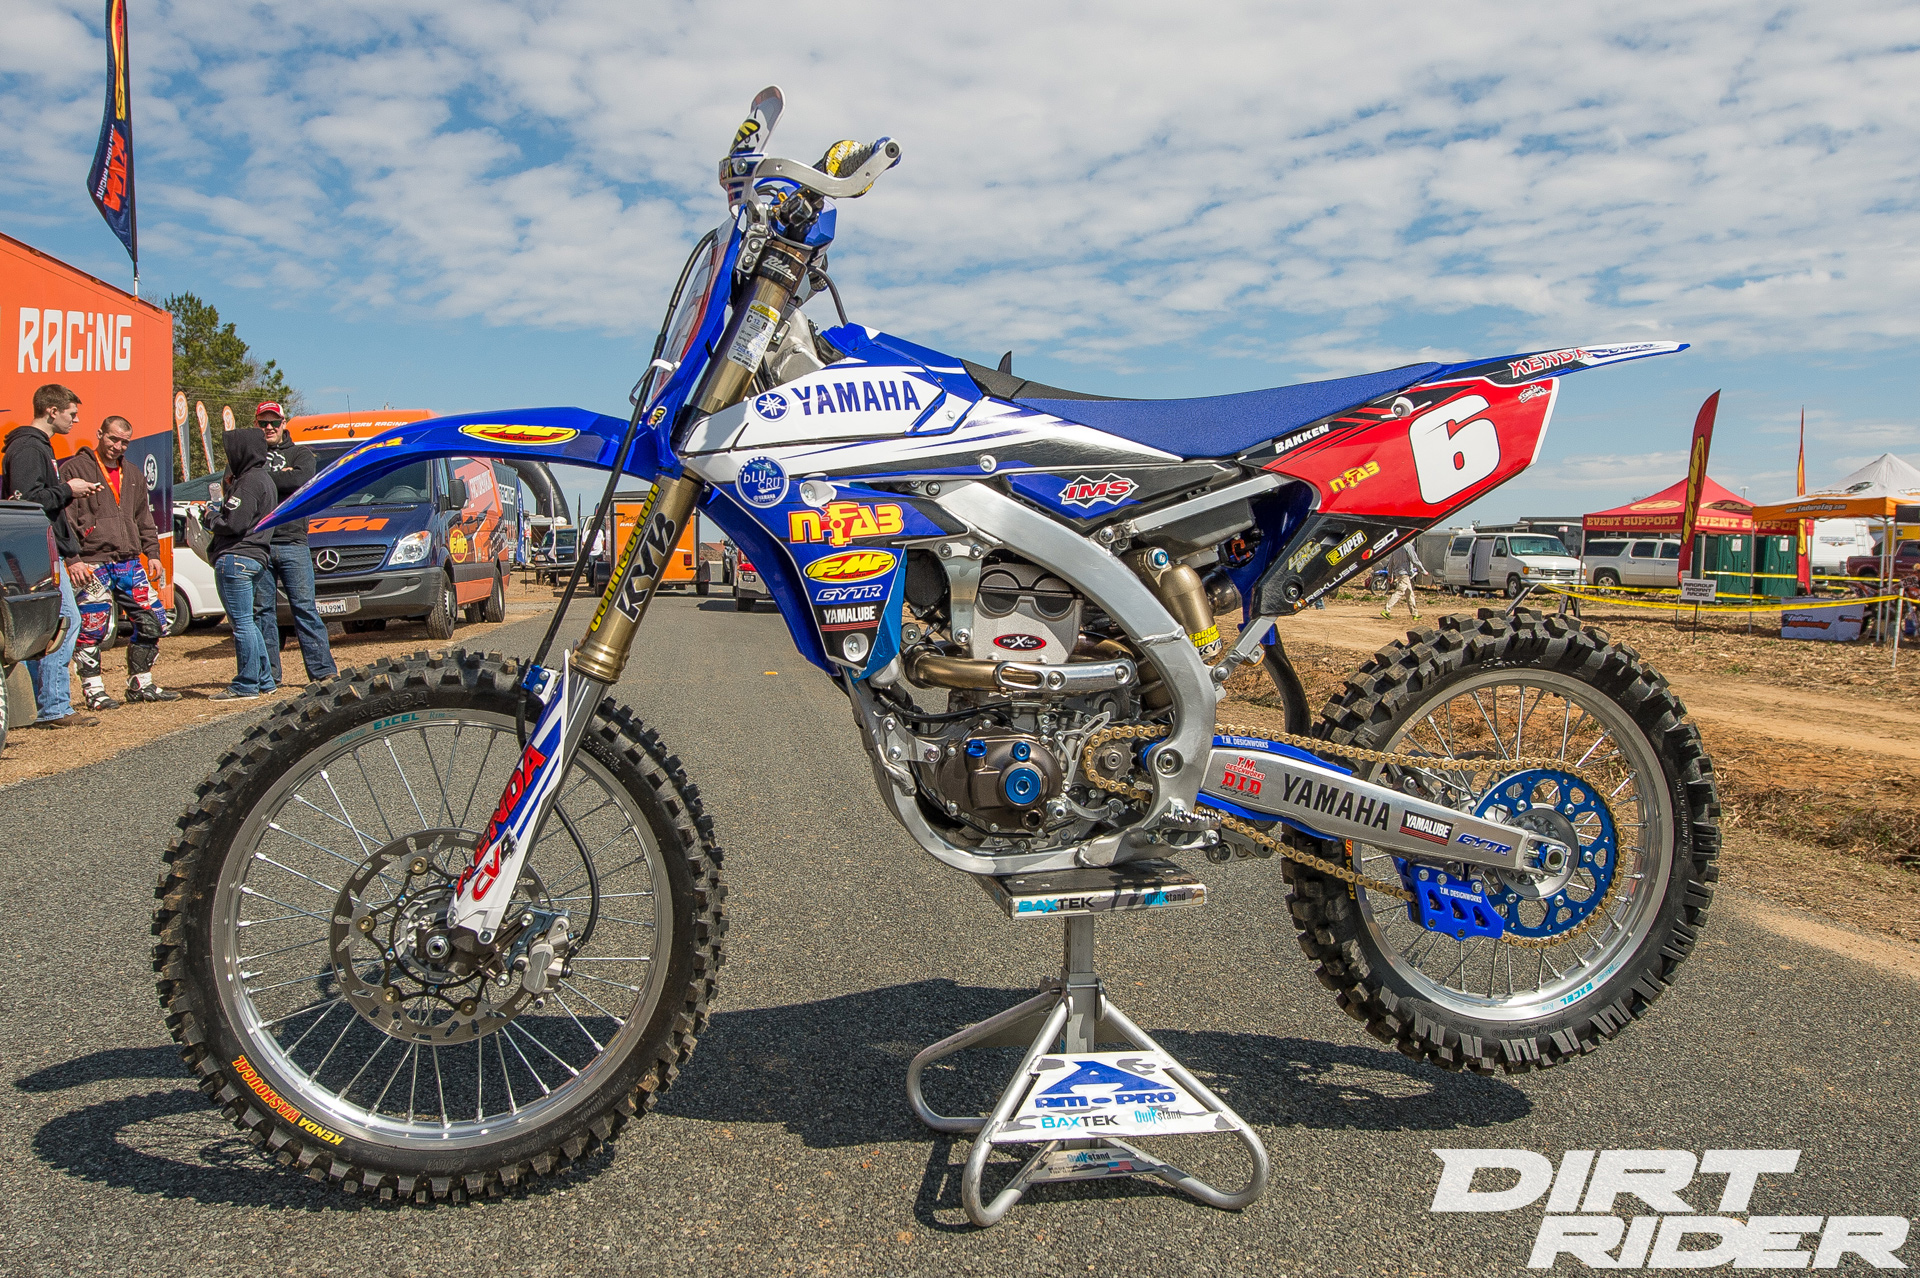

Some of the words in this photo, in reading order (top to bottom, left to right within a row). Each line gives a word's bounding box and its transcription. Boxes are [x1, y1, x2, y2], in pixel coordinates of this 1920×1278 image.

[1508, 348, 1592, 378] KENDA
[792, 381, 921, 415] YAMAHA
[462, 415, 577, 437] FMF
[1275, 424, 1329, 453] BAKKEN
[1409, 394, 1500, 504] 6
[758, 476, 780, 490] CRU
[1067, 481, 1132, 499] IMS
[1587, 517, 1620, 526] EVENT
[1623, 516, 1678, 526] SUPPORT
[1337, 531, 1365, 558] TAPER
[615, 512, 676, 622] KYB
[806, 554, 894, 578] FMF
[816, 585, 883, 601] GYTR
[1305, 562, 1358, 602] REKLUSE
[823, 606, 876, 624] YAMALUBE
[373, 713, 419, 731] EXCEL
[1283, 772, 1391, 831] YAMAHA
[455, 744, 548, 902] KENDA
[1405, 812, 1451, 839] YAMALUBE
[1455, 833, 1512, 856] GYTR
[1018, 896, 1095, 914] BAXTEK
[1560, 982, 1593, 1005] EXCEL
[232, 1055, 301, 1124] WASHOUGAL
[298, 1117, 345, 1146] KENDA
[1042, 1115, 1120, 1131] BAXTEK
